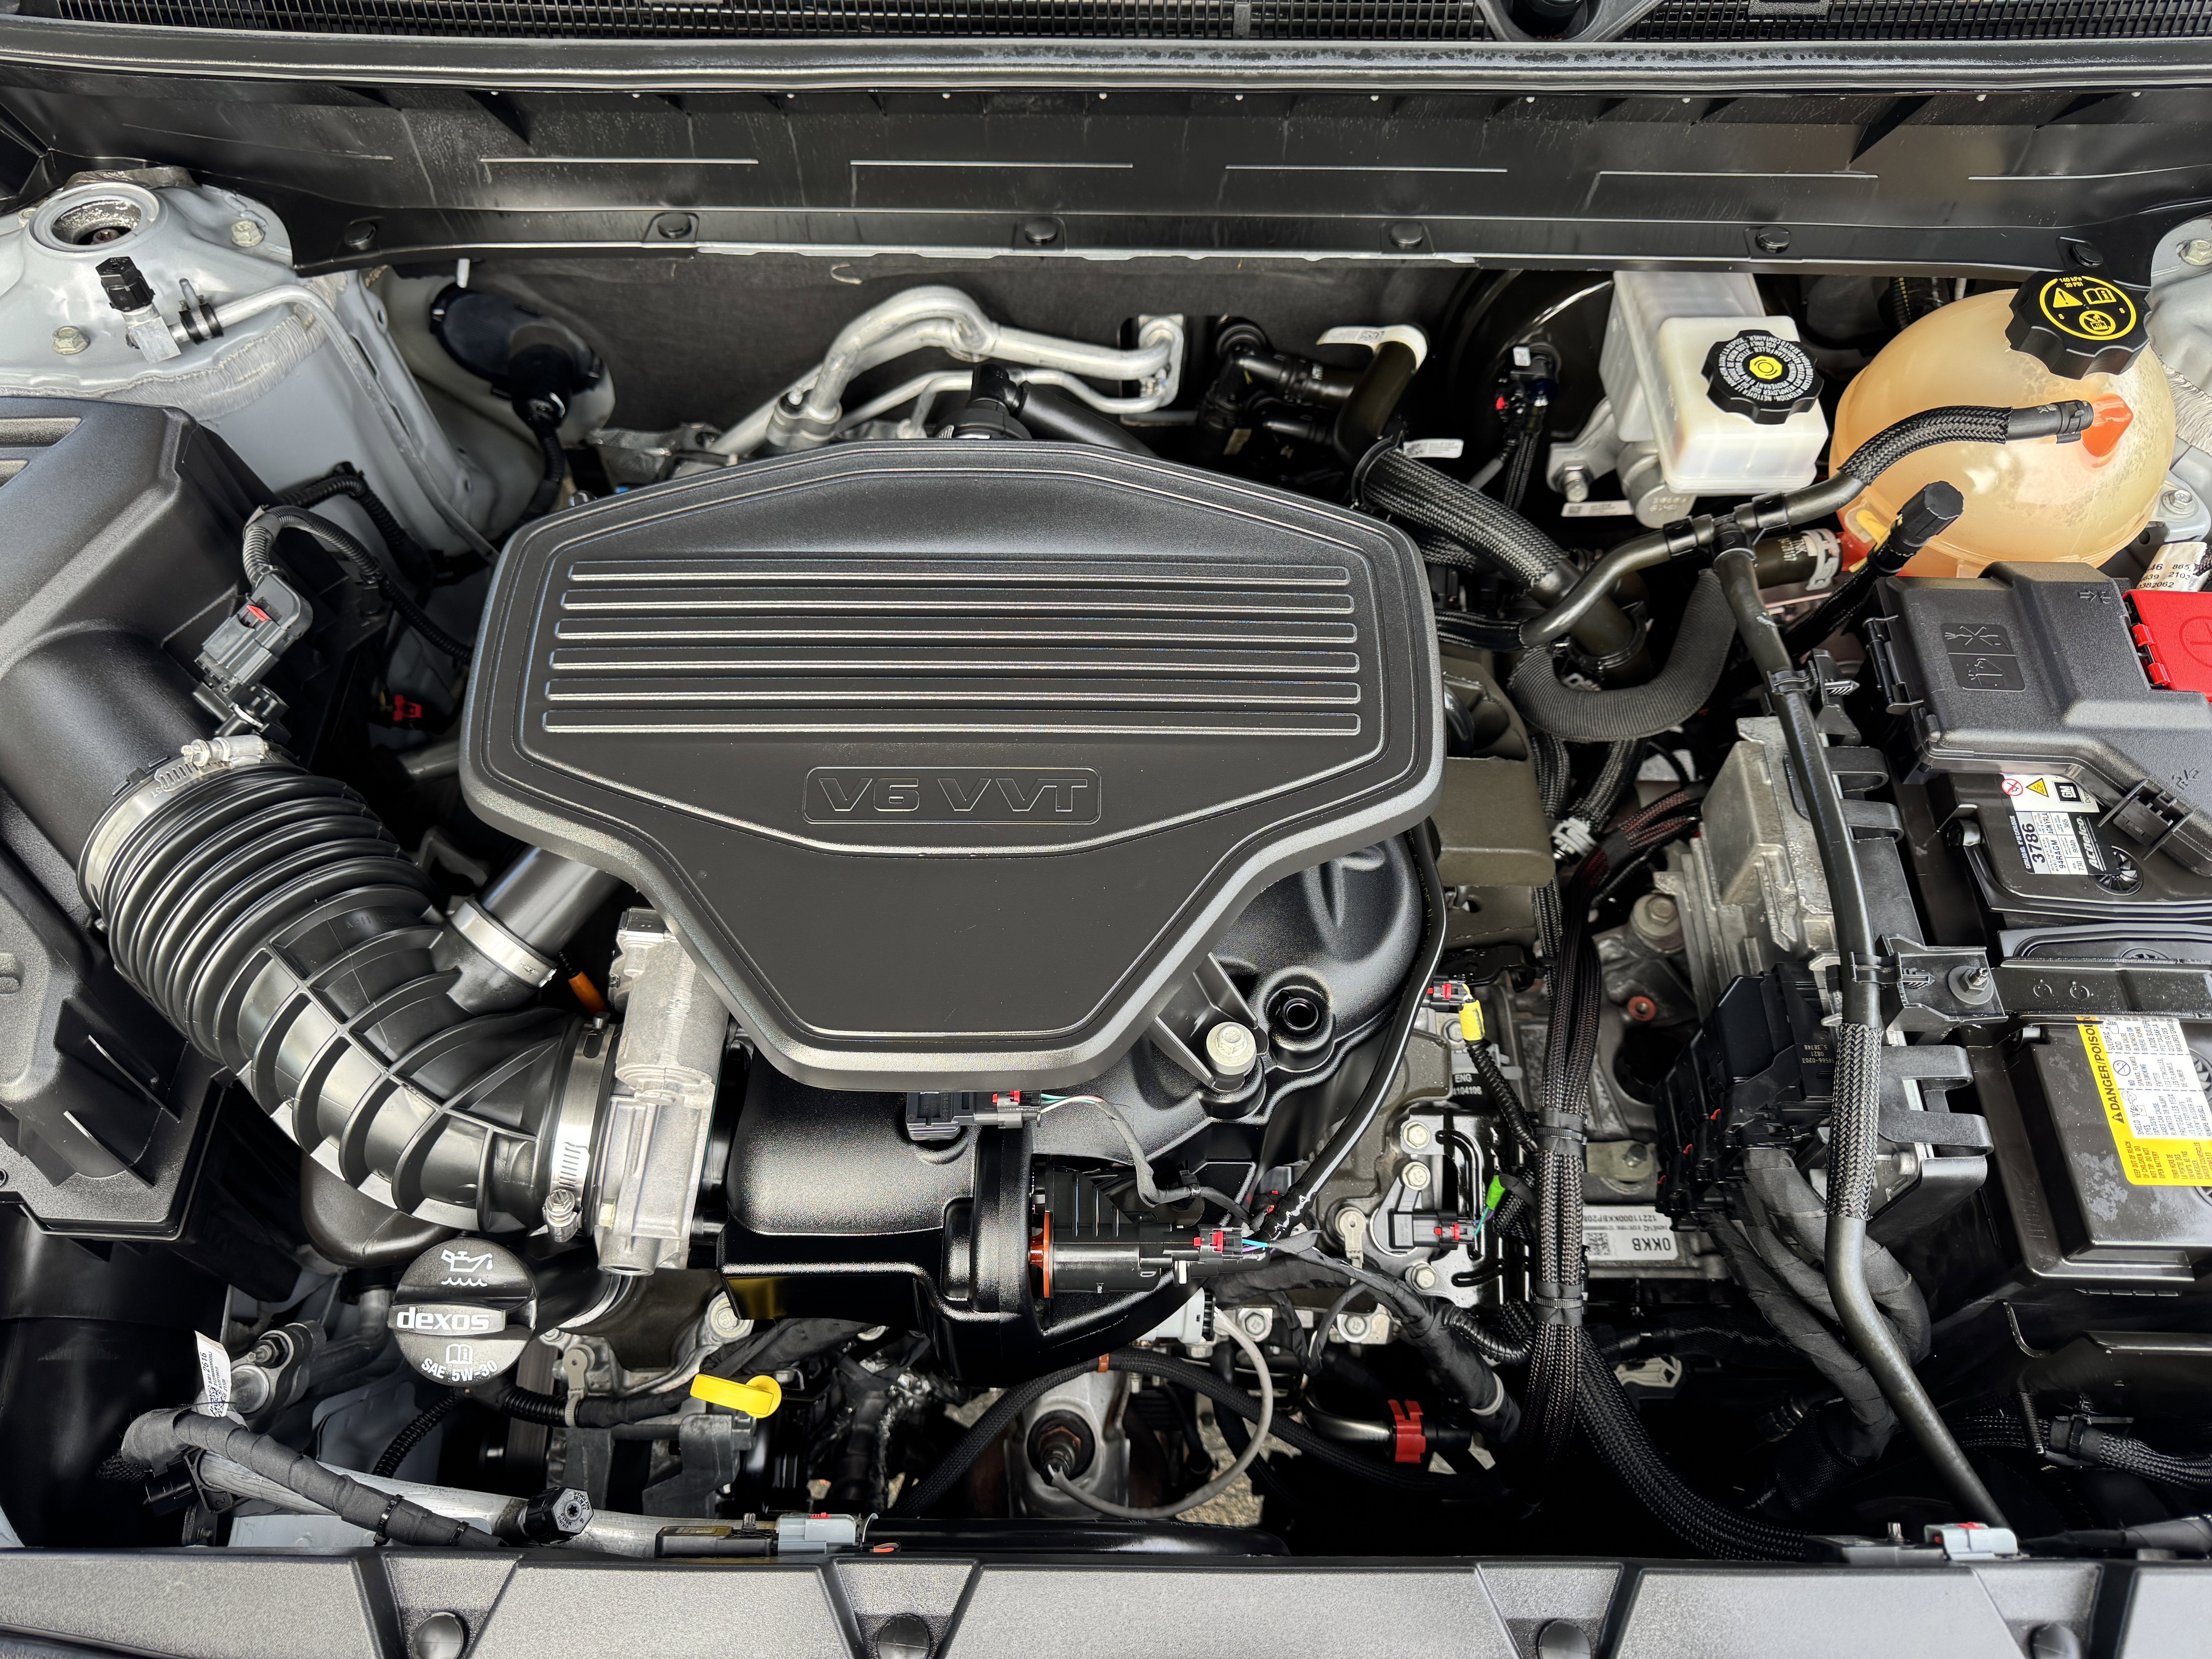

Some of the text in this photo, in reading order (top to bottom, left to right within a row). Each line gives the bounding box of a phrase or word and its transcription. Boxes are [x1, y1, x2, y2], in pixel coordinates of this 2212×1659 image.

[818, 778, 1088, 812] V6 VVT
[2059, 786, 2073, 798] GM
[2009, 816, 2020, 835] CATALOGUE
[2022, 824, 2045, 863] 3786
[2076, 817, 2099, 869] ACDelco
[2021, 853, 2031, 869] CATALOG
[2051, 840, 2066, 869] 94RAGM
[2076, 861, 2085, 871] 730
[1455, 1073, 1472, 1083] ENG
[397, 1307, 489, 1331] dexos
[200, 1352, 210, 1373] 2616
[421, 1358, 498, 1382] SAE 5W-30
